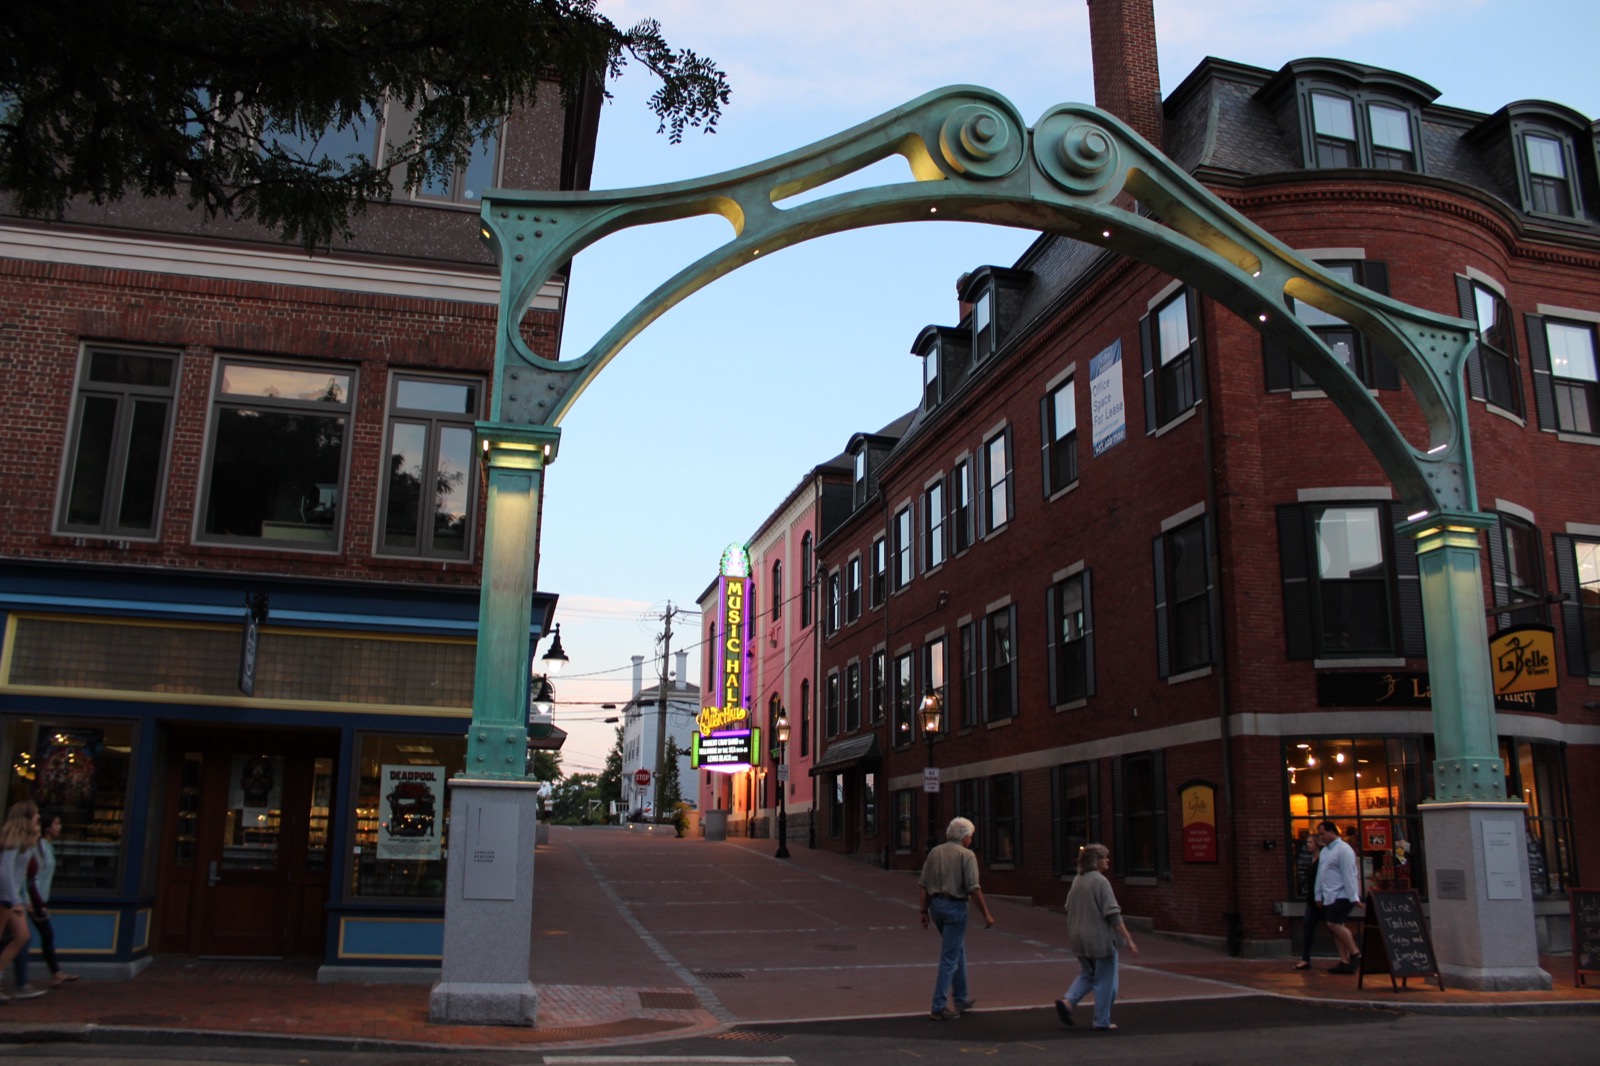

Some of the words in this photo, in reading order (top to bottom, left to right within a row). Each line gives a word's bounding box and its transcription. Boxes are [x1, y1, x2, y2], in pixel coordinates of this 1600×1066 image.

[1093, 379, 1110, 397] Office
[1093, 394, 1112, 413] Space
[1094, 414, 1104, 427] For
[1105, 402, 1123, 420] Lease
[727, 582, 743, 652] MUSIC
[1526, 668, 1549, 676] Winery
[390, 771, 437, 782] DEADPOOL
[636, 773, 650, 781] STOP
[1380, 901, 1412, 913] Wine
[1385, 917, 1420, 933] Tasting
[1388, 933, 1410, 947] Today
